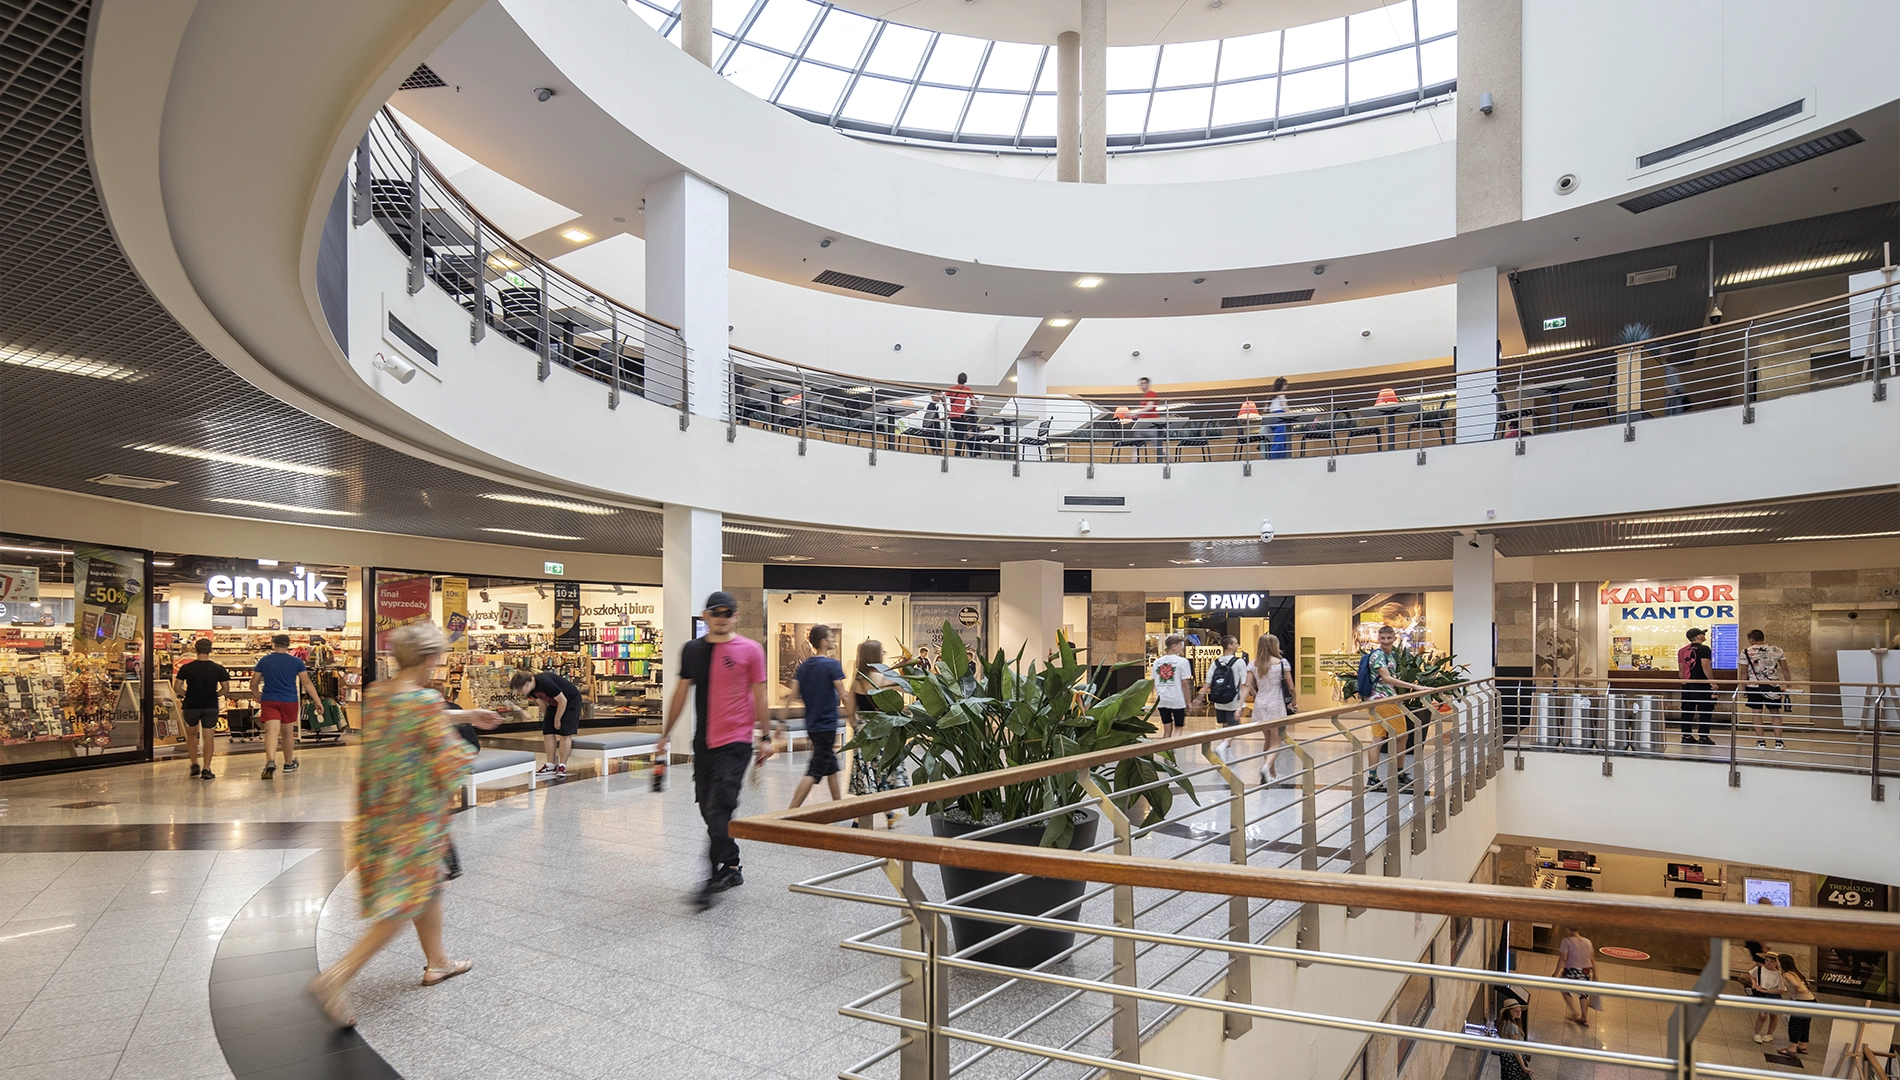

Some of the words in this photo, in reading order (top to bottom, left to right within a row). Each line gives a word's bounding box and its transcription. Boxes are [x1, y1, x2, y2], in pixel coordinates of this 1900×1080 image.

[207, 566, 329, 606] empik
[90, 587, 128, 604] -50%
[380, 589, 399, 598] finał
[556, 590, 567, 598] 10
[568, 589, 577, 598] zł
[1601, 585, 1735, 605] KANTOR
[380, 601, 428, 610] wyprzedaży
[1210, 593, 1260, 610] PAWO
[580, 605, 593, 616] Do
[593, 603, 622, 617] szkoły
[624, 603, 628, 614] i
[629, 603, 655, 615] biura
[1622, 605, 1735, 620] KANTOR
[1199, 648, 1222, 656] PAWO
[69, 709, 105, 724] empik
[108, 709, 139, 721] bilety
[1829, 883, 1860, 892] TRENUJ
[1828, 890, 1861, 906] 49
[1864, 899, 1875, 908] zł
[1827, 976, 1862, 985] FITNESS
